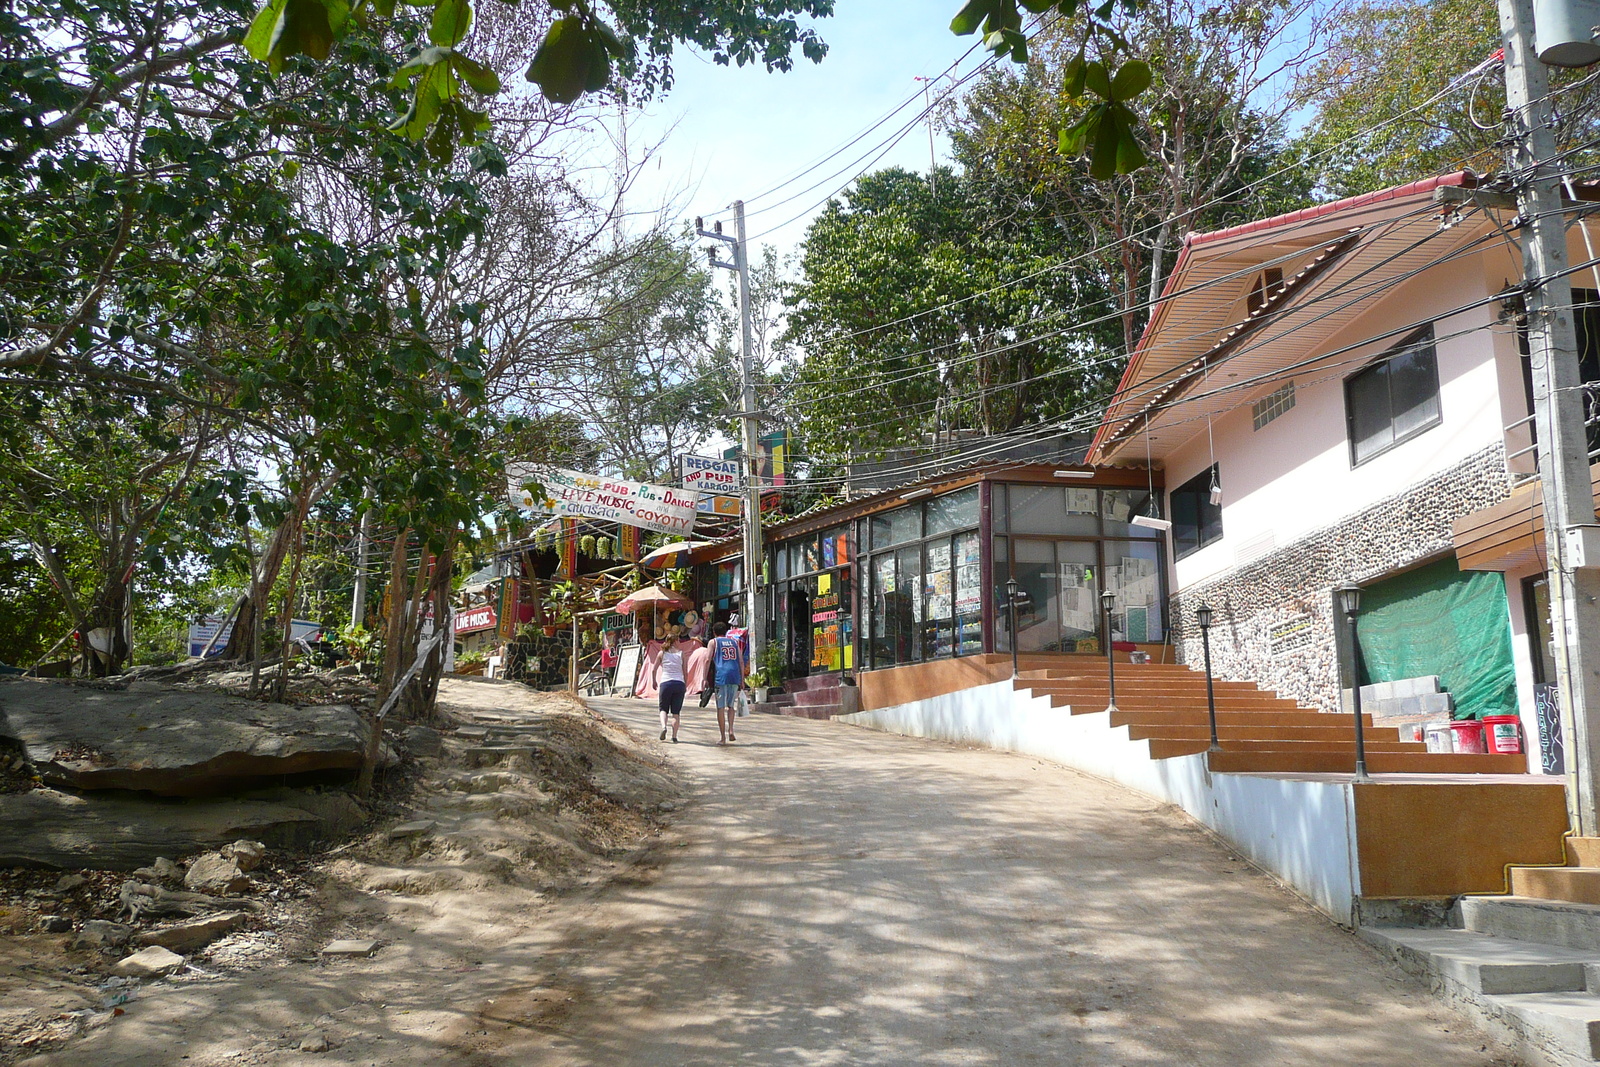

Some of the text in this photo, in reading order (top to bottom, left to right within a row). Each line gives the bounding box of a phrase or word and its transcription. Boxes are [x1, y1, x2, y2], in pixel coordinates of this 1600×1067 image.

[686, 457, 737, 474] REGGAE
[685, 472, 734, 484] AND PUB
[697, 481, 739, 491] KARAOKE
[561, 489, 635, 510] LIVE MUSIC
[603, 483, 629, 496] PUB
[663, 491, 696, 510] DANCE
[636, 509, 690, 529] COYOTY
[456, 616, 470, 630] LIVE
[470, 611, 490, 627] MUSIC
[607, 614, 623, 629] PUB
[721, 646, 737, 661] 33
